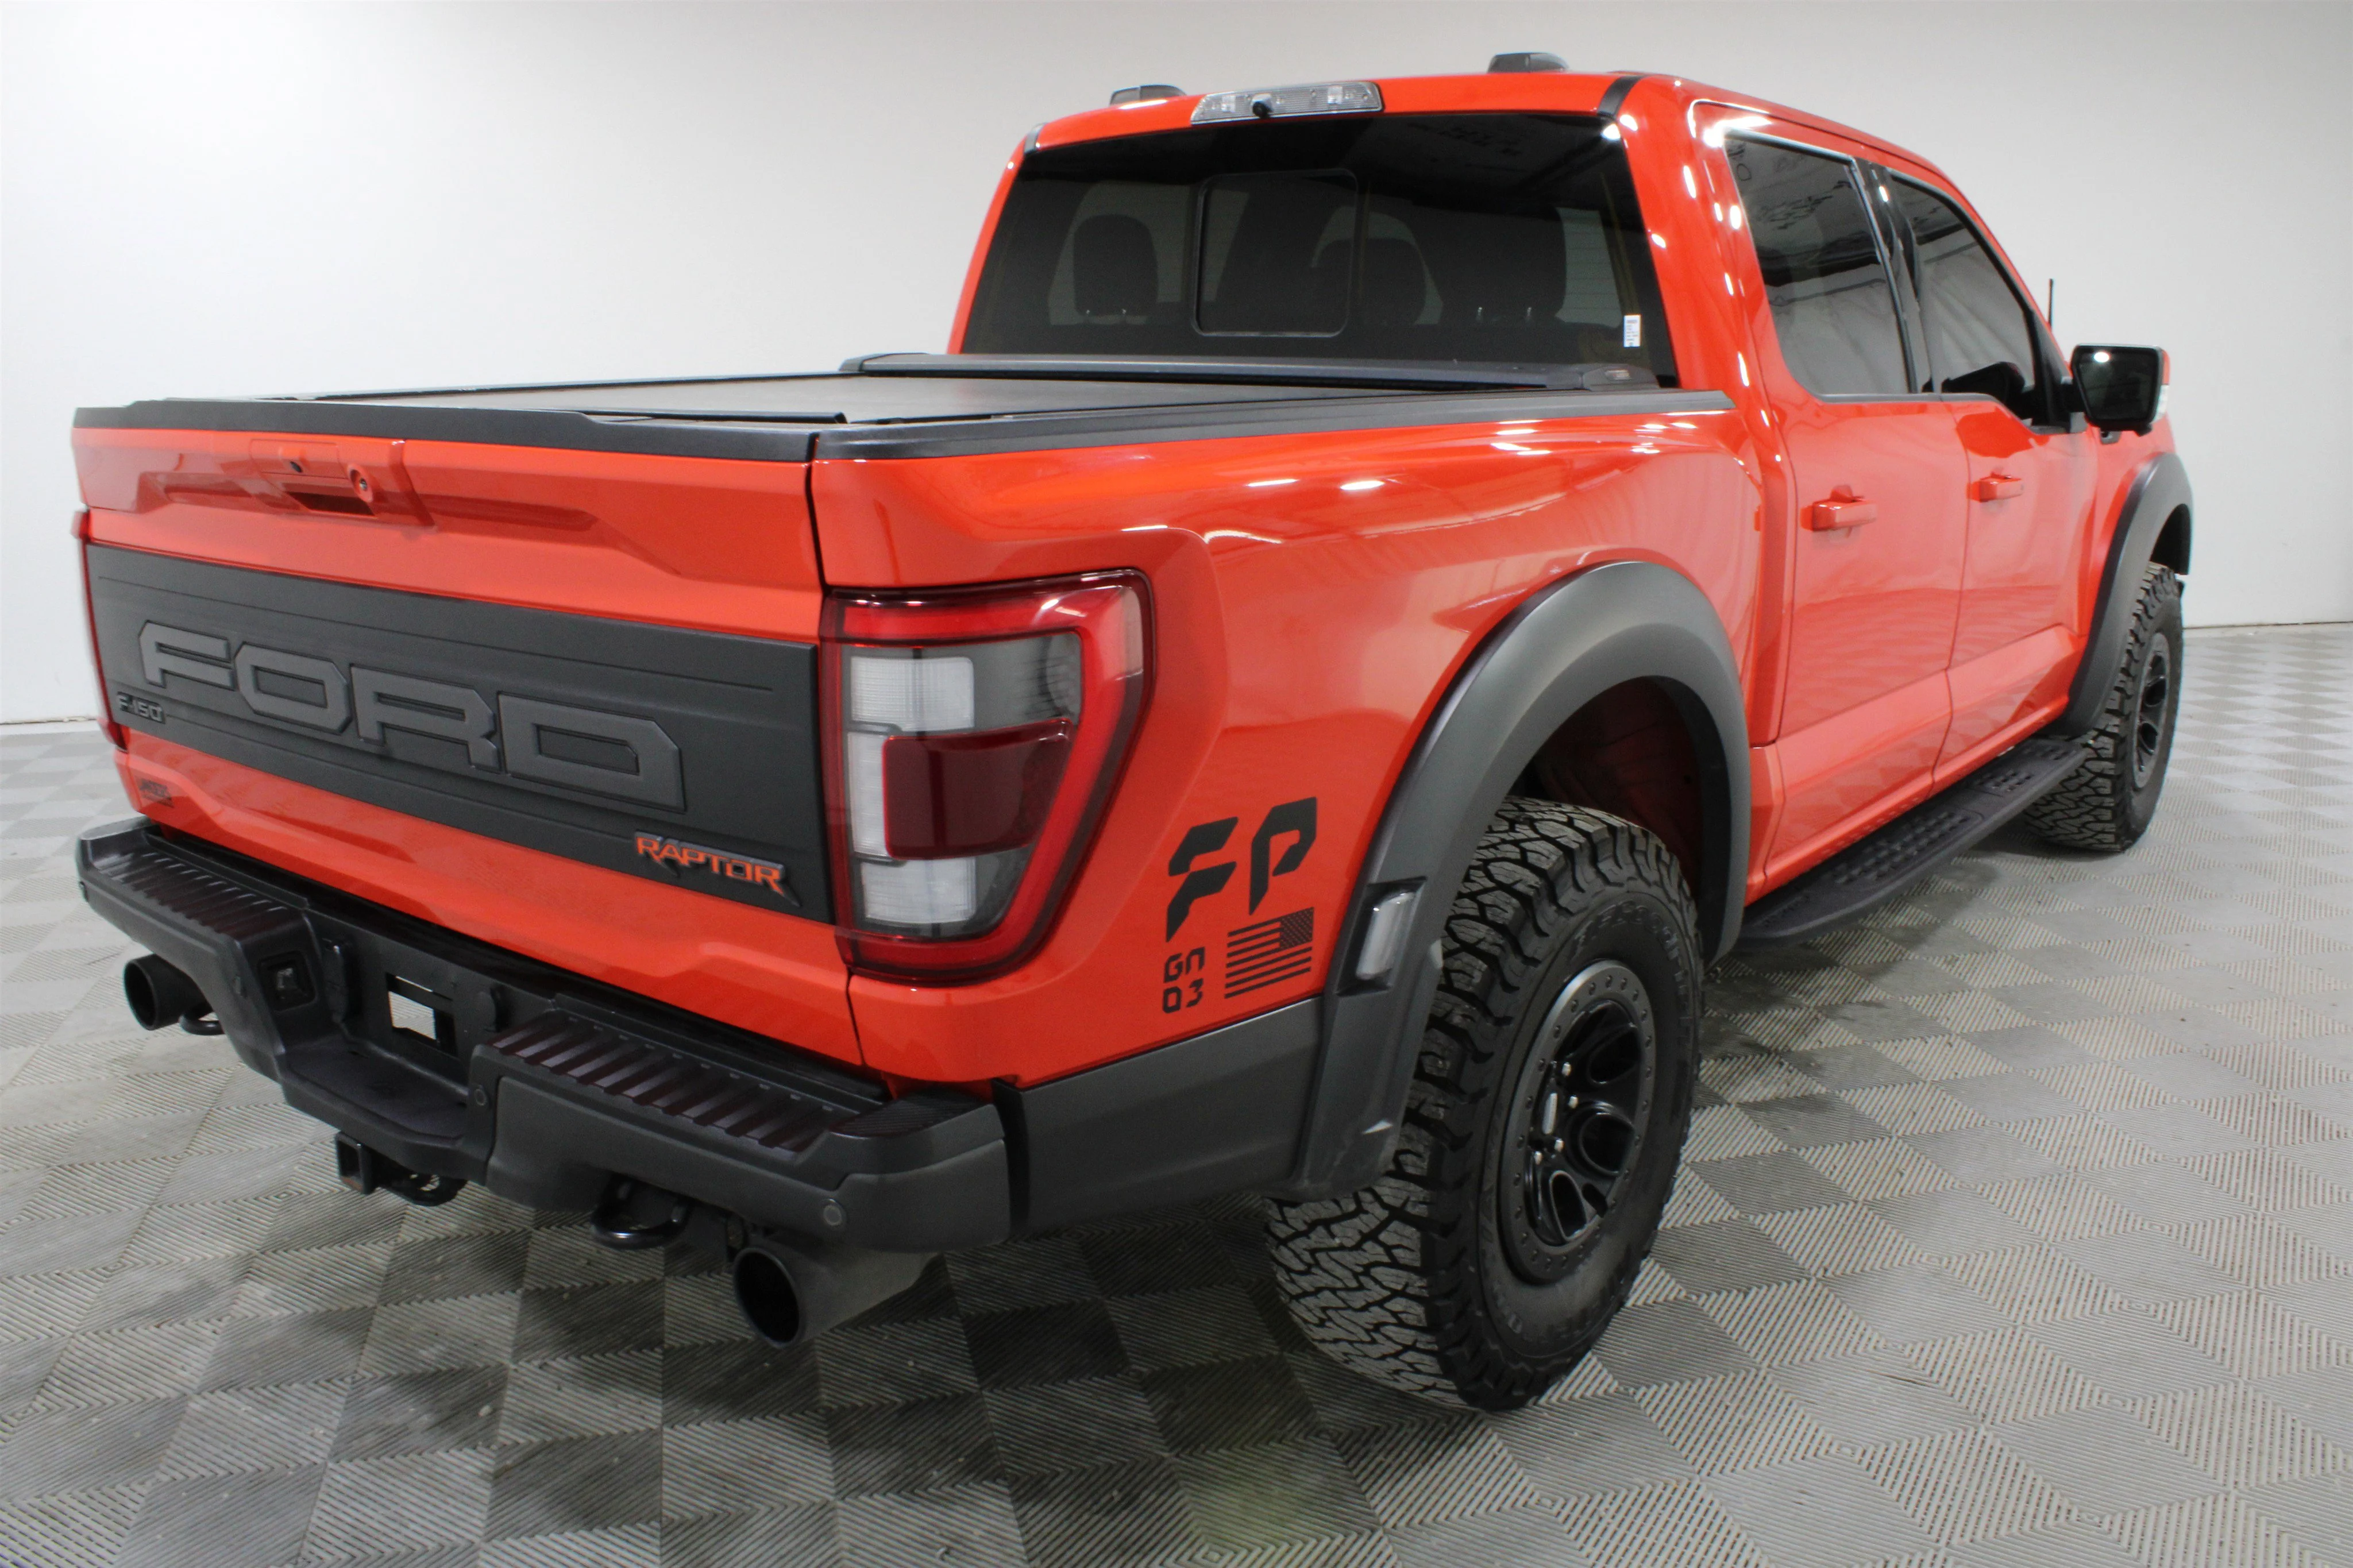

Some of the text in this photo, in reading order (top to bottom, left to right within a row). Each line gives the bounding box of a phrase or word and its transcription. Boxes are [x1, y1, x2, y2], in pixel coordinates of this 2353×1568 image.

[116, 693, 165, 724] F-150
[138, 619, 687, 814] FORD
[635, 831, 795, 901] RAPTOR
[1166, 797, 1317, 943] FP
